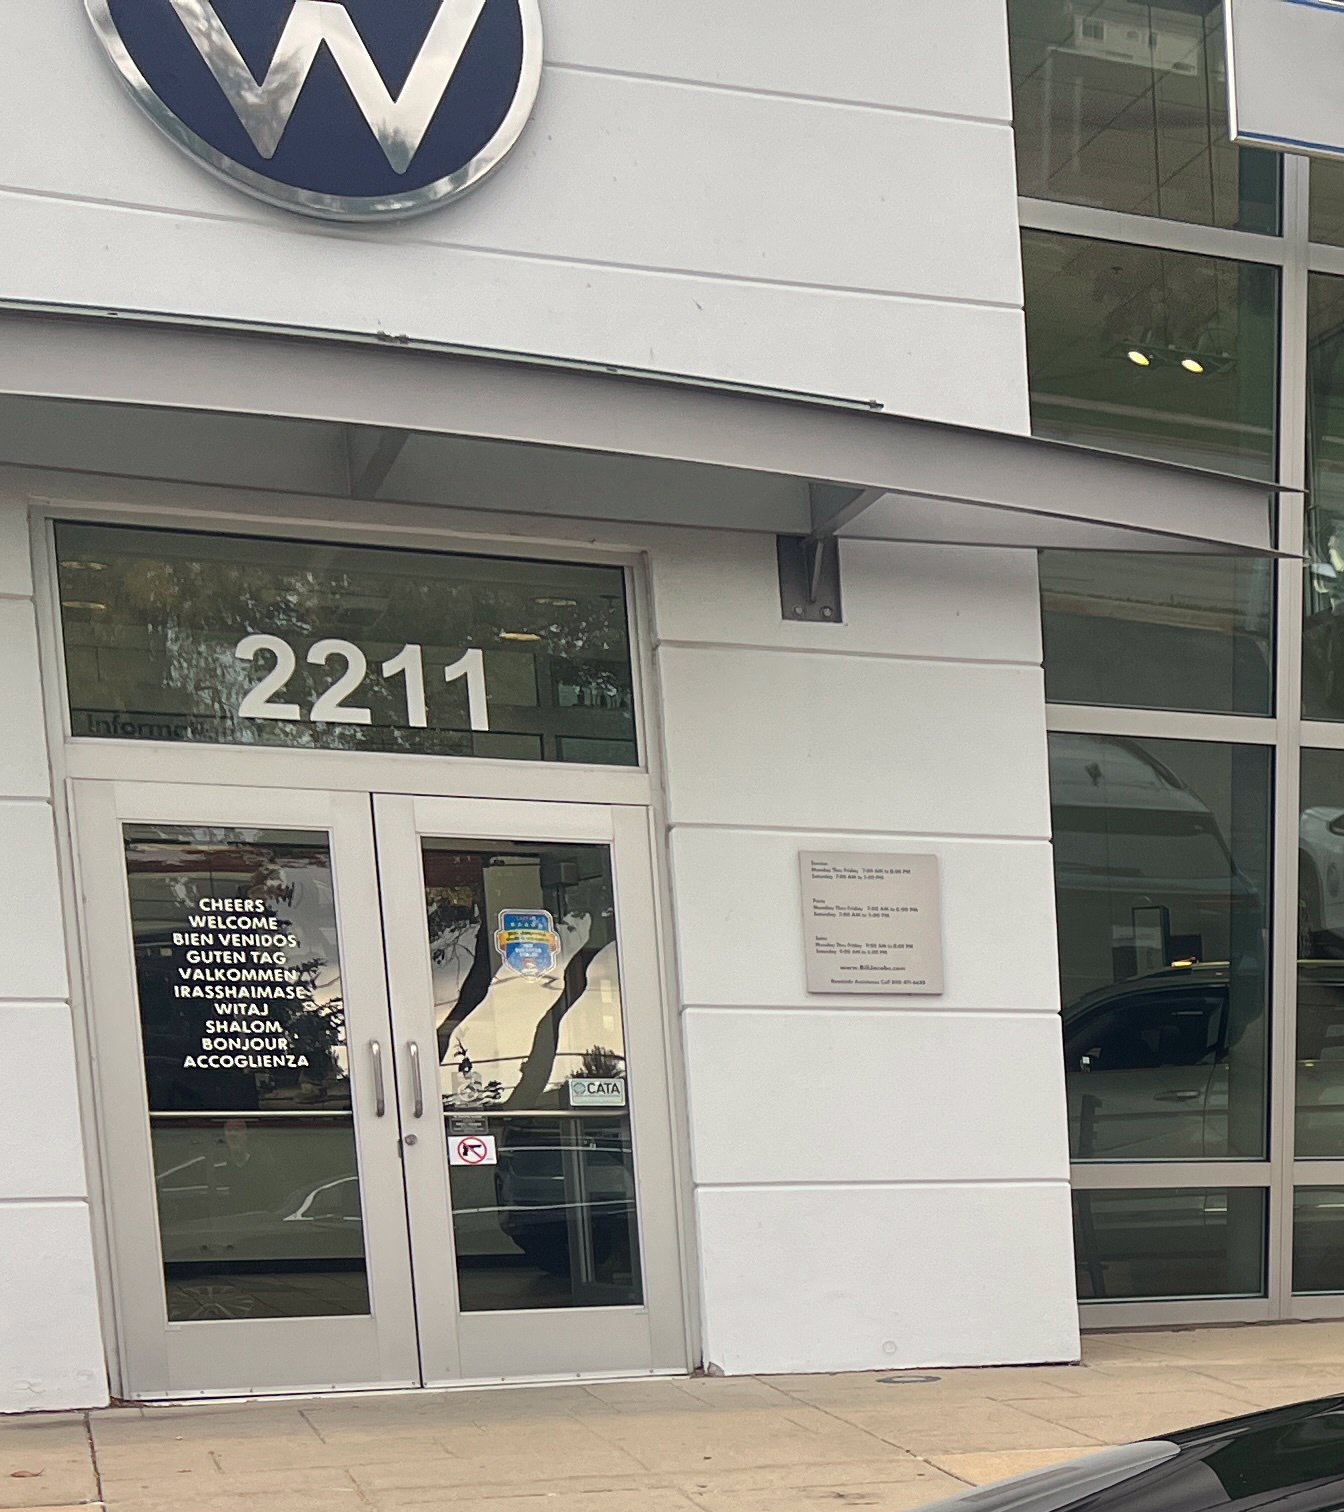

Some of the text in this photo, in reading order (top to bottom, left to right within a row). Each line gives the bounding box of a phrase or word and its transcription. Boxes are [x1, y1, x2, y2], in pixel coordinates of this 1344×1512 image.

[235, 634, 489, 731] 2211
[199, 898, 265, 913] CHEERS
[188, 915, 278, 930] WELCOME
[172, 933, 297, 947] BIEN VENIDOS
[186, 950, 286, 964] GUTEN TAG
[178, 967, 299, 981] VALKOMMEN
[174, 985, 310, 999] IRASSHAIMASE
[214, 1003, 269, 1016] WITAJ
[205, 1020, 283, 1033] SHALOM
[202, 1037, 289, 1050] BONJOUR
[183, 1055, 309, 1069] ACCOGLIENZA
[587, 1082, 621, 1095] CATA
